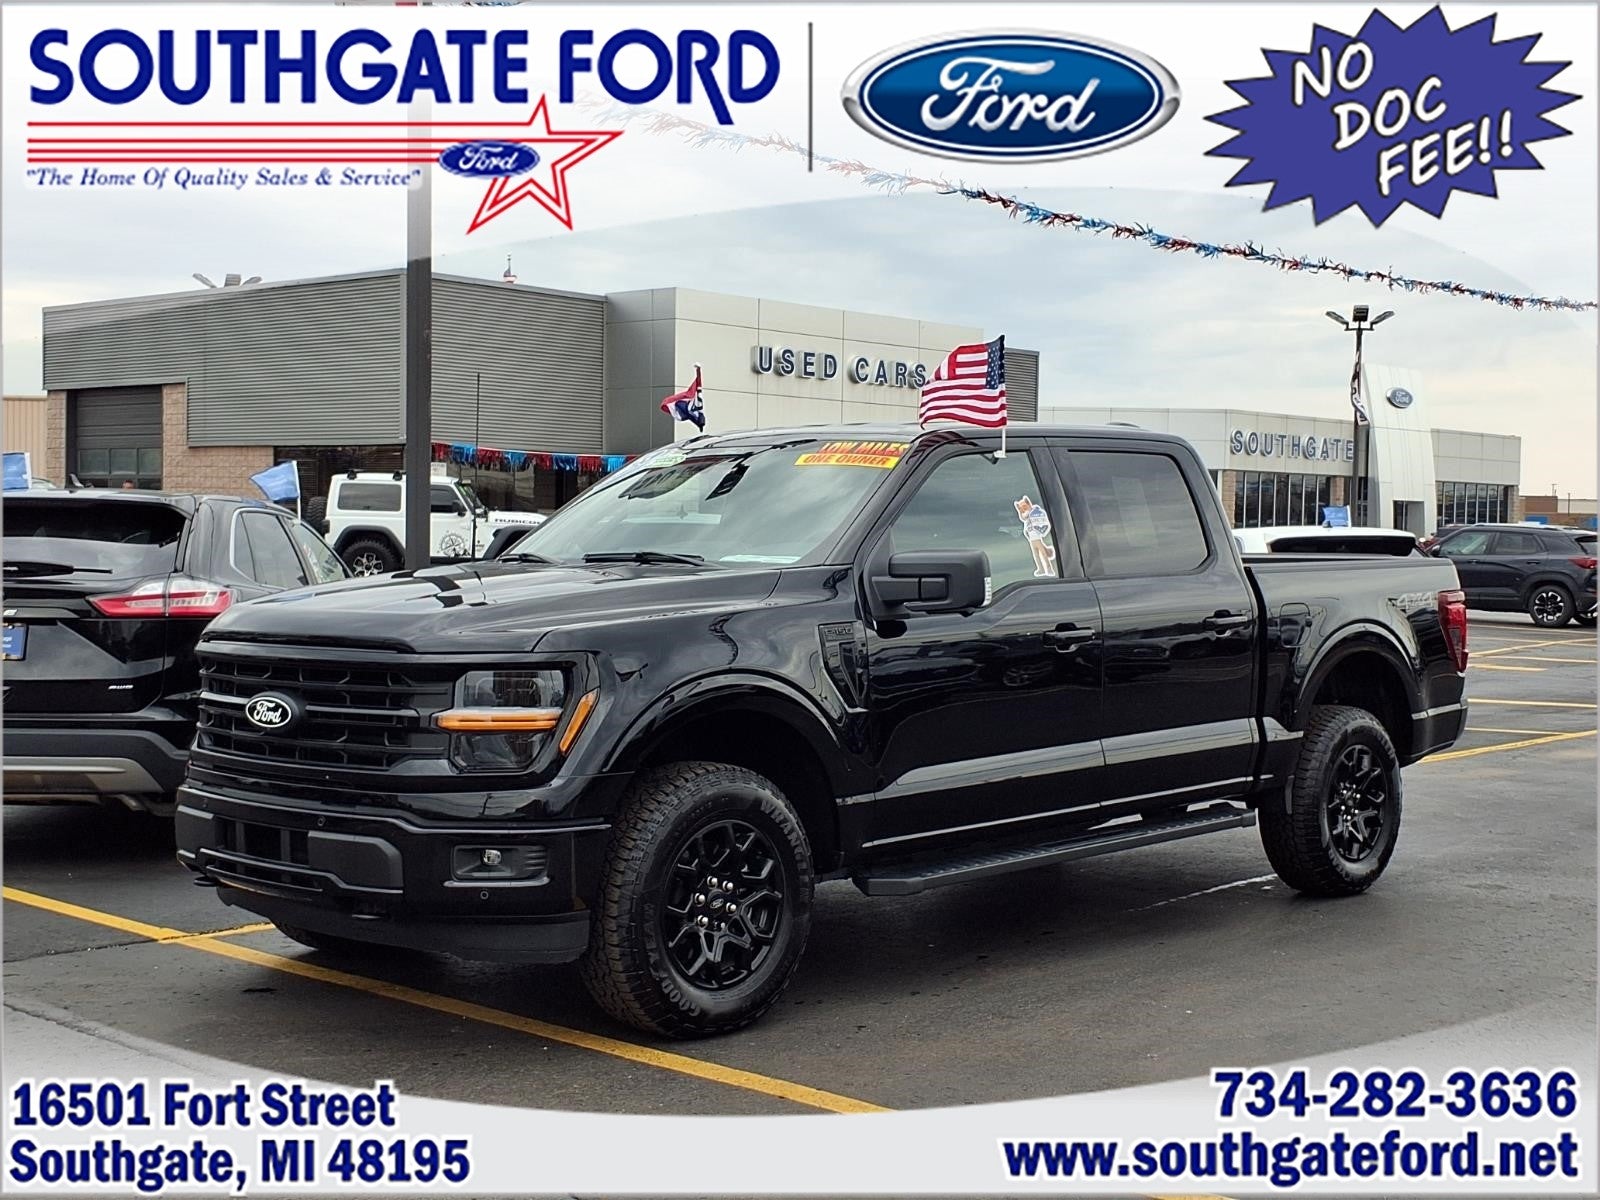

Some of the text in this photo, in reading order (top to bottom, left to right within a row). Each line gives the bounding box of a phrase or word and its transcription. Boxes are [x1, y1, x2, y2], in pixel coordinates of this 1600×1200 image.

[755, 346, 926, 388] USED CARS
[817, 441, 911, 457] LOW MILES
[1231, 429, 1354, 461] SOUTHGATE
[803, 454, 890, 466] ONE OWNER
[253, 700, 283, 723] Ford
